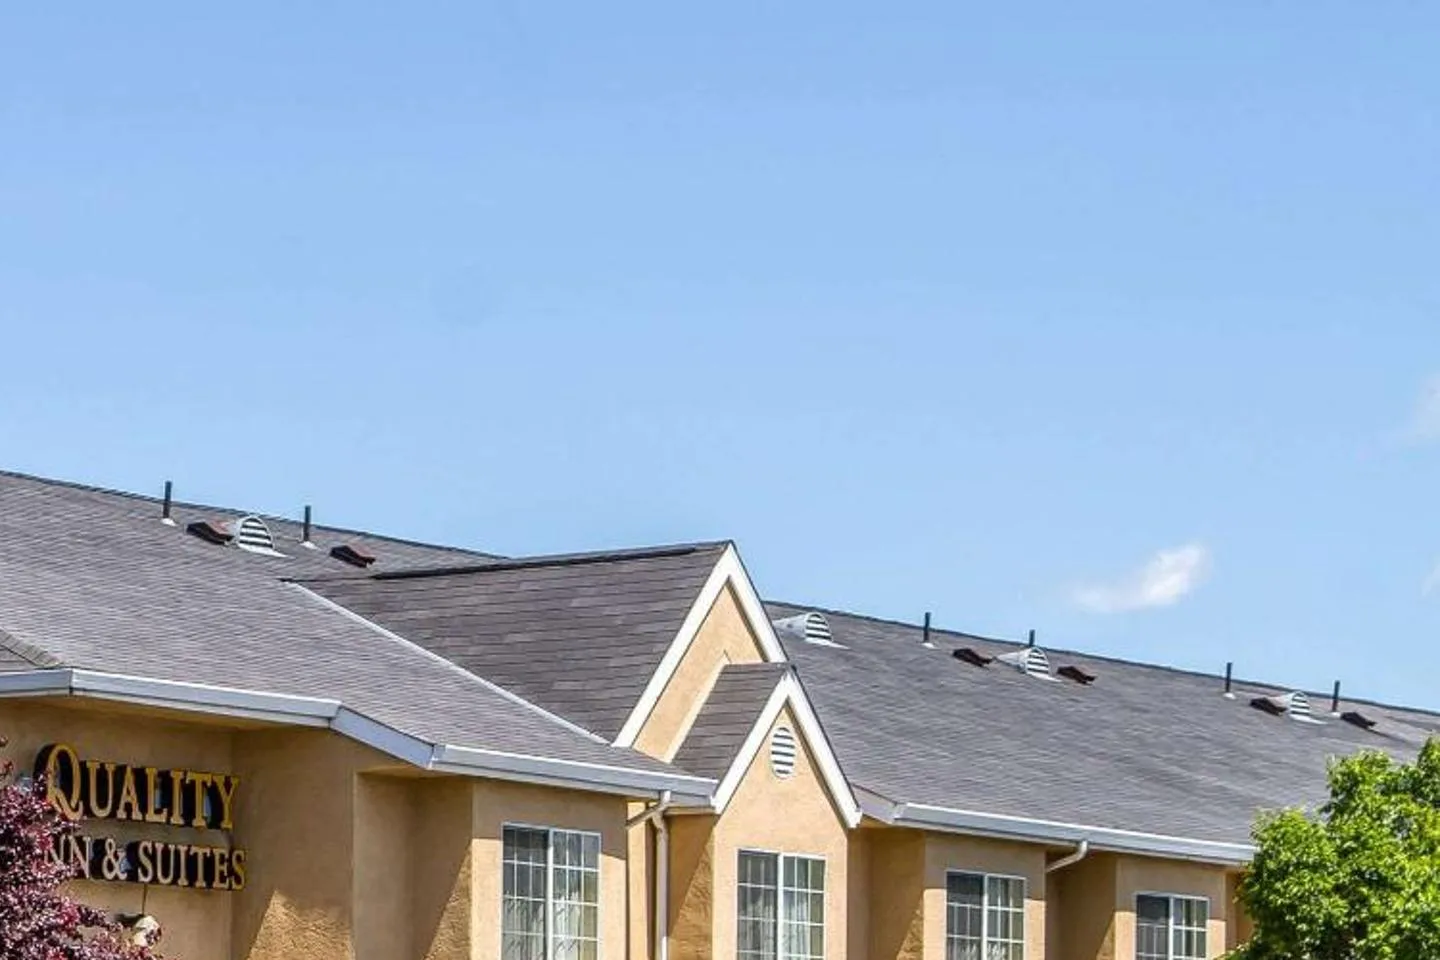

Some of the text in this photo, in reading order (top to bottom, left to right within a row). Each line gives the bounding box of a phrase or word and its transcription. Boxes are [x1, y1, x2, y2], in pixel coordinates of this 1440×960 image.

[43, 744, 240, 830] QUALITY
[102, 838, 127, 880] &
[137, 841, 246, 889] SUITES
